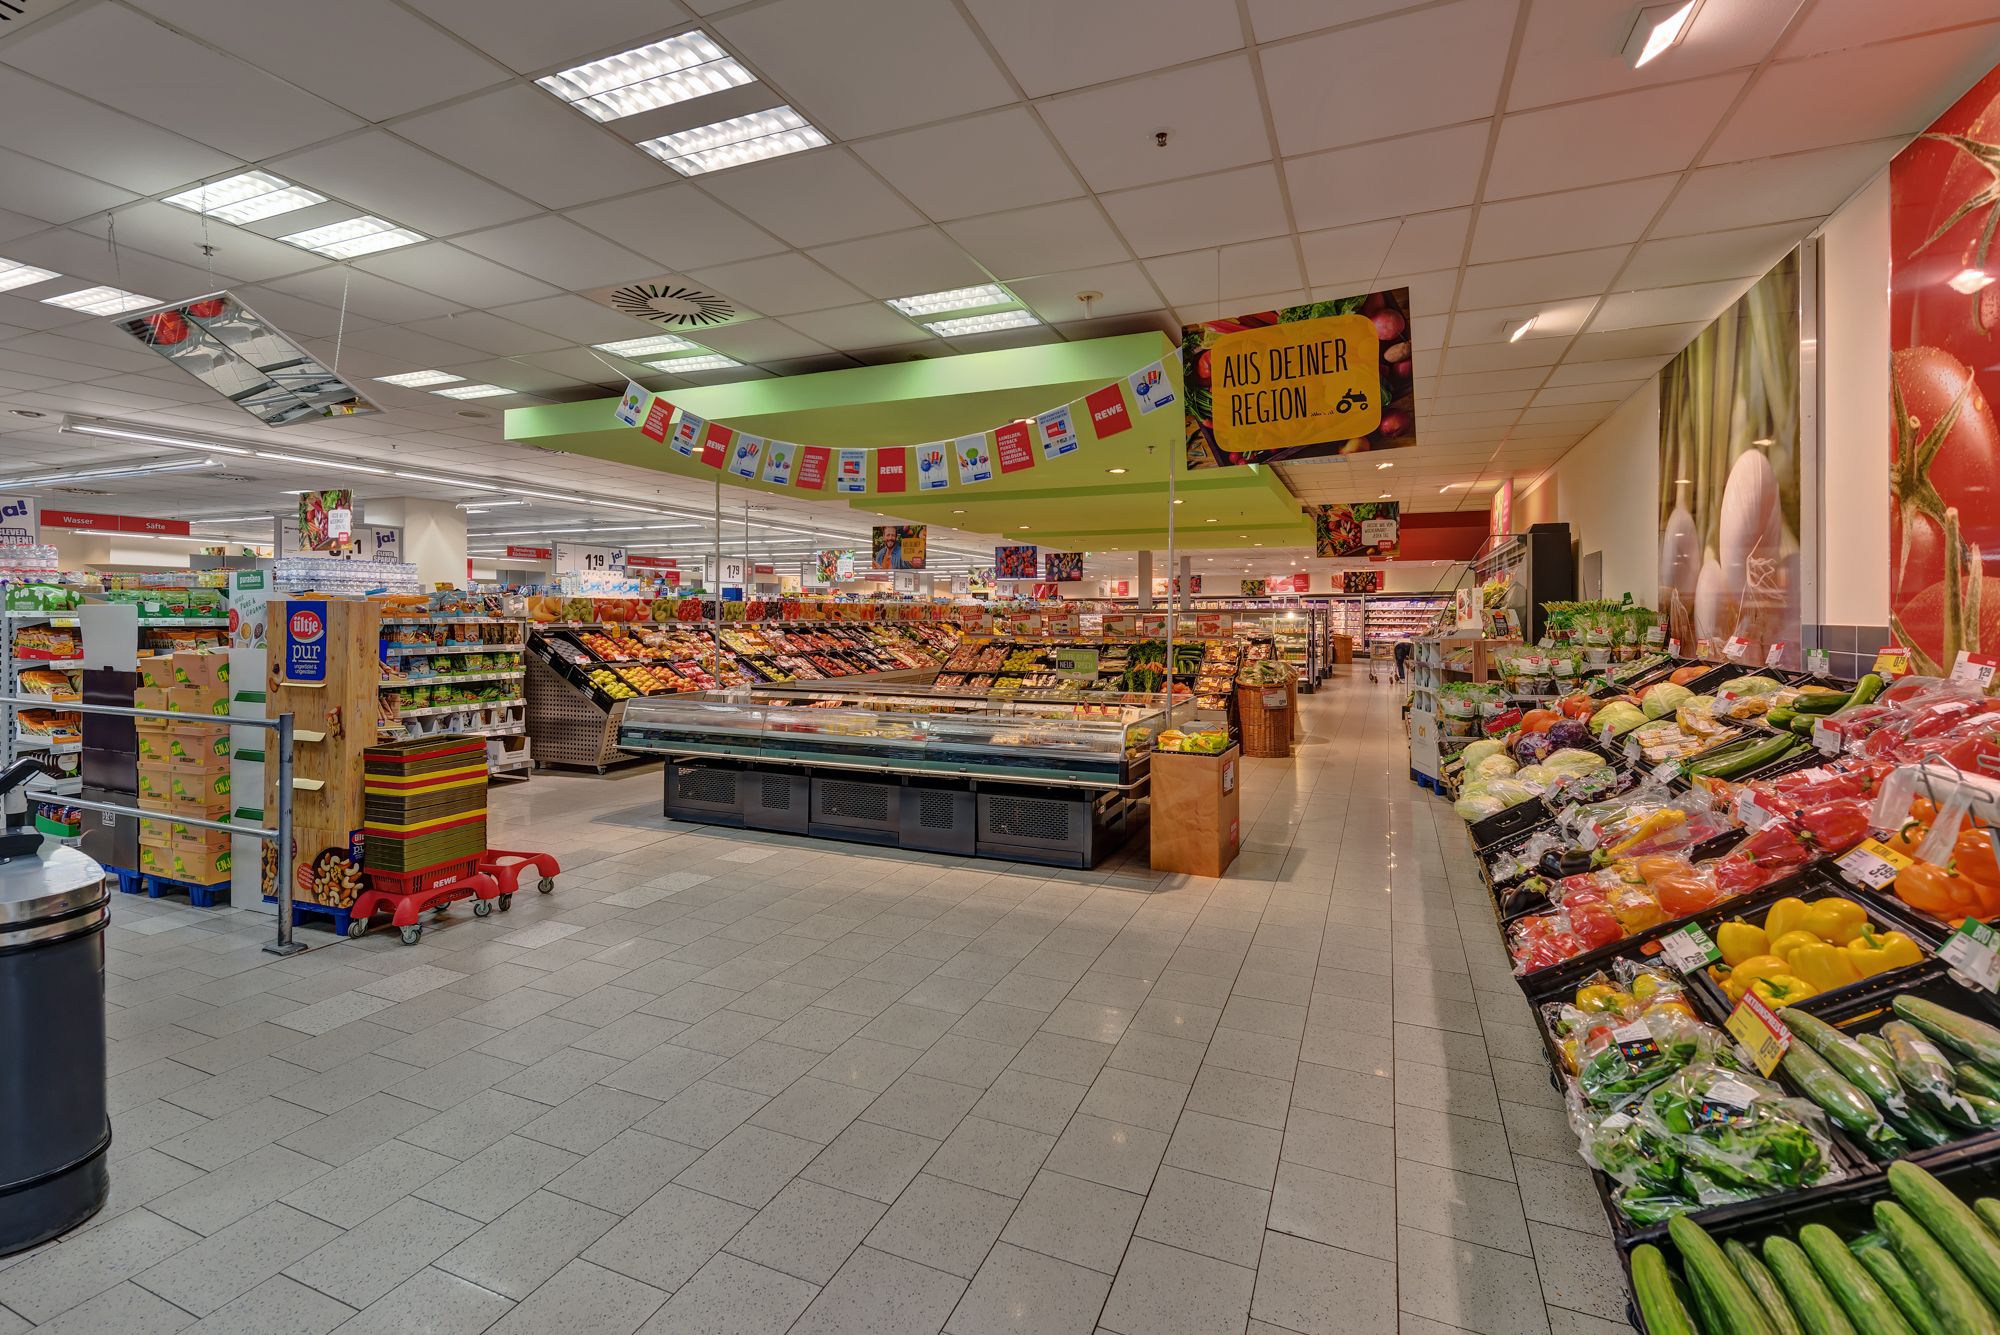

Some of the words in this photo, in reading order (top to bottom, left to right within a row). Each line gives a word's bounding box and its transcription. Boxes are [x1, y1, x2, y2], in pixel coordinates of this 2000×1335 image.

[1223, 351, 1261, 389] AUS
[1269, 338, 1349, 382] DEINER
[1094, 403, 1123, 422] REWE
[1231, 385, 1308, 427] REGION
[706, 439, 726, 453] REWE
[880, 465, 904, 475] REWE
[63, 516, 94, 525] Wasser
[146, 522, 166, 530] Säfte
[376, 531, 395, 548] ja!
[585, 554, 604, 570] 1.19
[611, 549, 623, 564] ja!
[727, 564, 740, 578] 1.79
[240, 600, 251, 610] PURE
[293, 617, 319, 635] ültje
[292, 644, 321, 662] pur
[1060, 661, 1074, 669] NEUE
[1869, 863, 1897, 879] 3.99
[433, 876, 457, 888] REWE
[1690, 929, 1707, 944] BIO
[1971, 925, 1993, 944] BIO
[1743, 993, 1781, 1033] AKTIONSPREIS
[1760, 1035, 1780, 1060] 0.99
